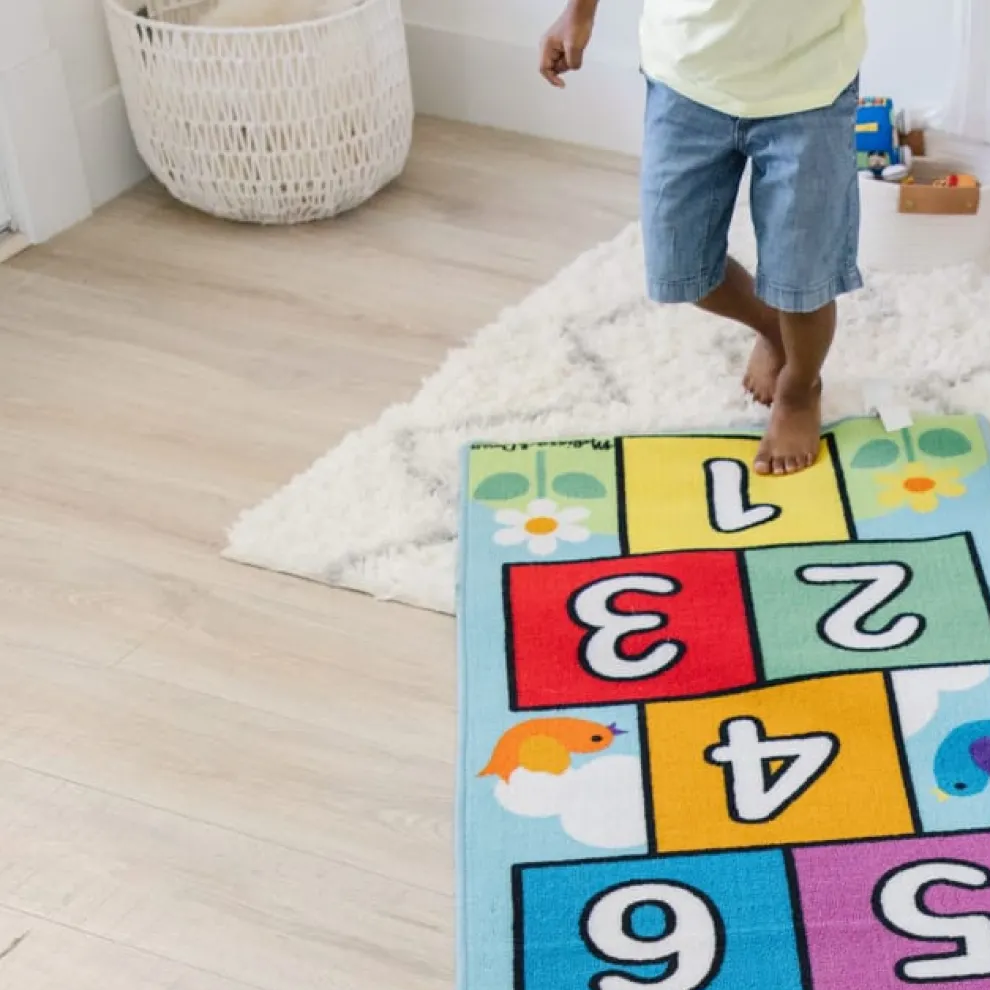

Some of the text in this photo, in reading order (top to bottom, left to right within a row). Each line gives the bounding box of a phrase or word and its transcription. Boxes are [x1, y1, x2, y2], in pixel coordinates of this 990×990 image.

[704, 457, 782, 534] 1
[567, 573, 687, 682] 3
[795, 562, 927, 651] 2
[704, 715, 841, 824] 4
